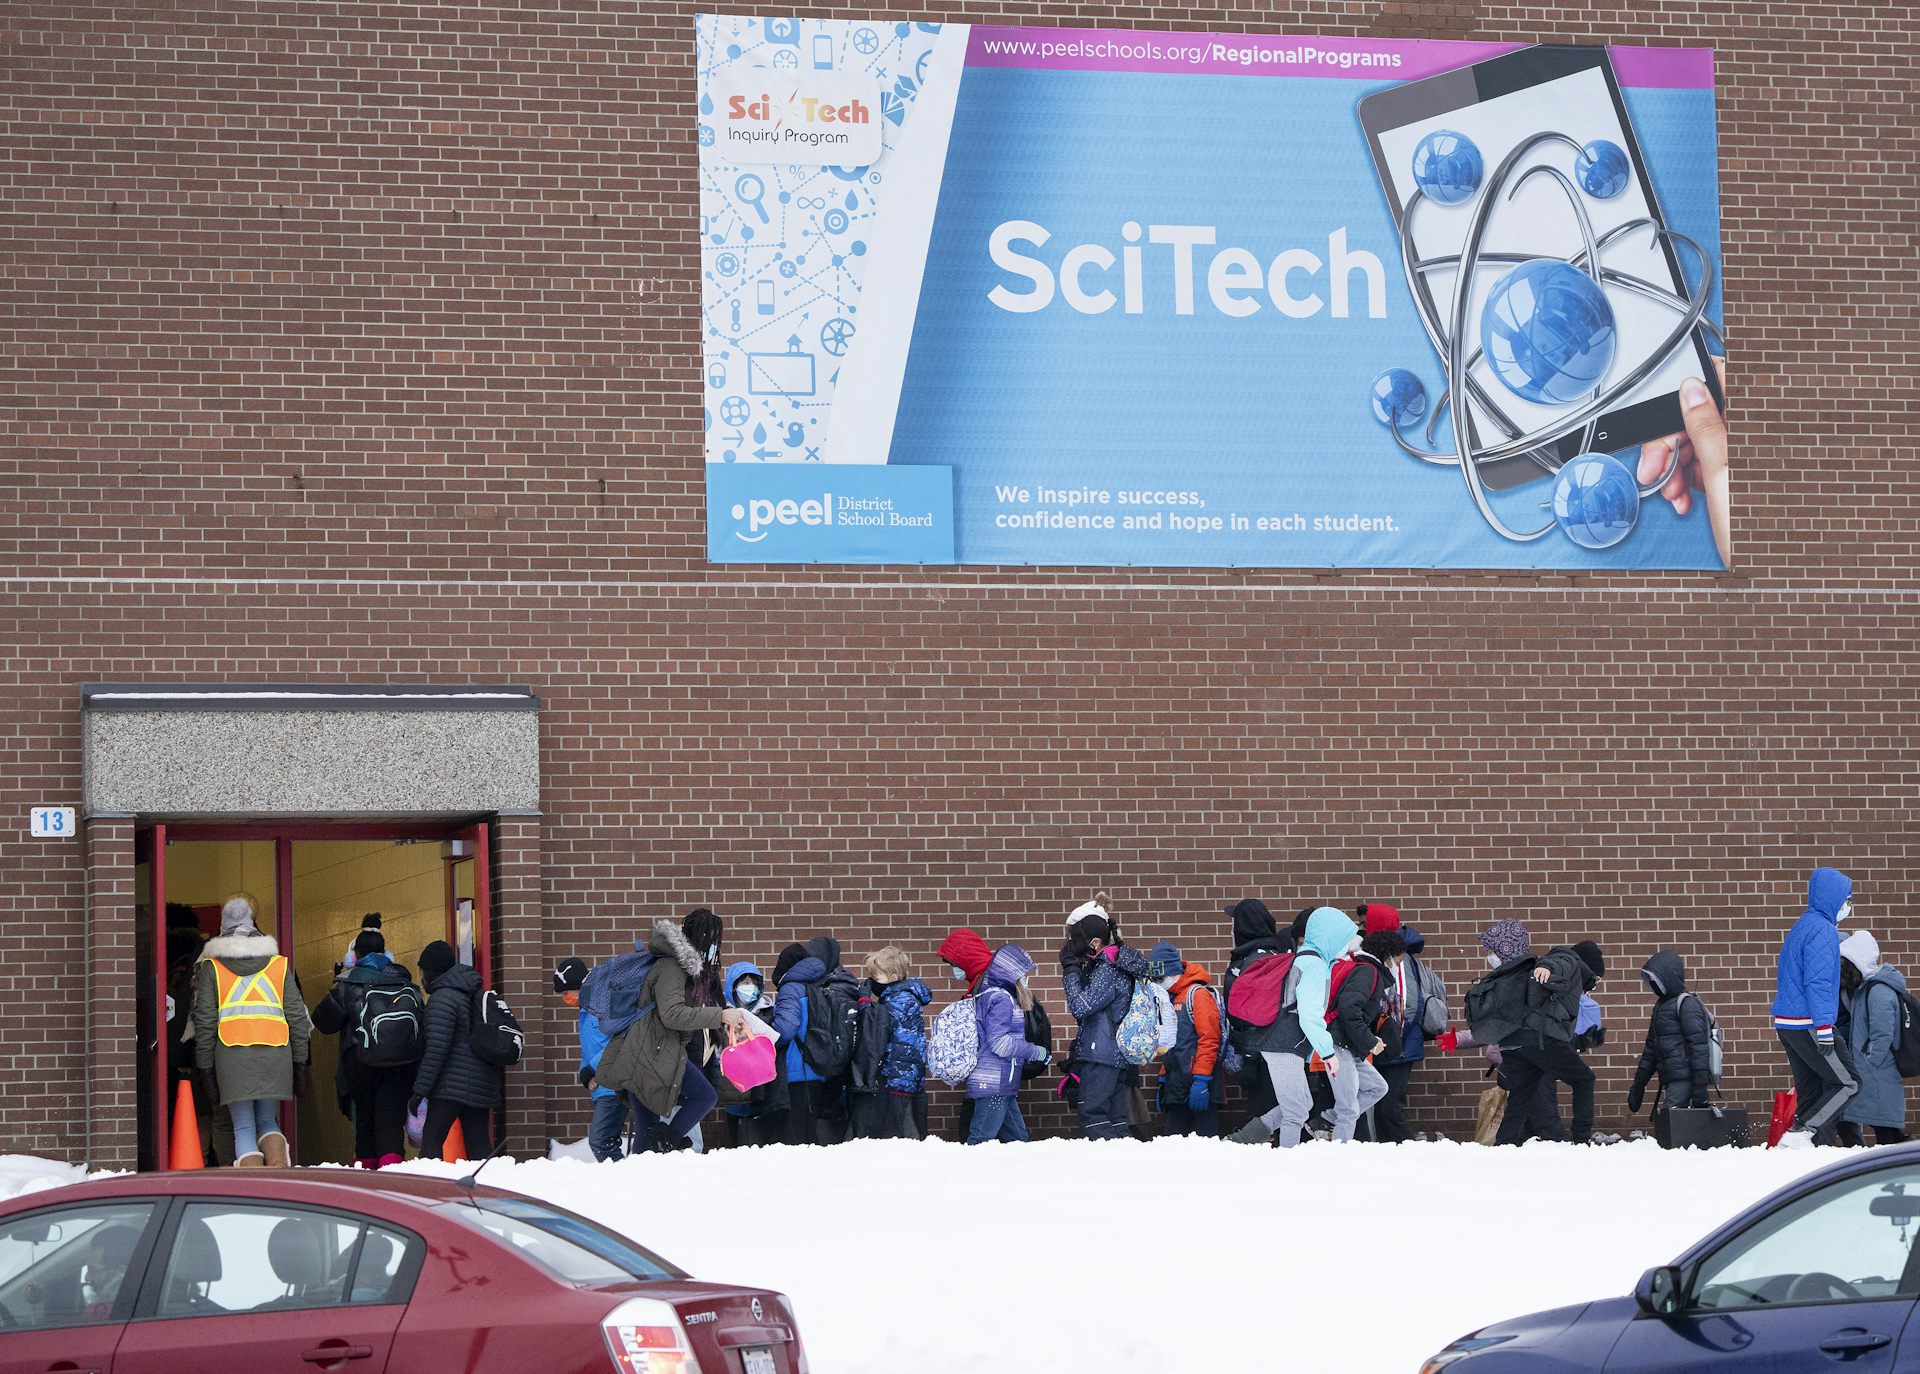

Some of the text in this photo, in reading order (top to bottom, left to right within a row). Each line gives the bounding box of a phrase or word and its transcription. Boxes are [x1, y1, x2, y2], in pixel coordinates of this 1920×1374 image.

[983, 38, 1402, 68] www.peelschools.org/RegionalPrograms
[728, 93, 869, 124] Sci Tech
[728, 126, 849, 147] Inquiry Program
[986, 219, 1387, 320] SciTech
[837, 496, 894, 511] District
[995, 485, 1206, 509] We inspire success,
[750, 493, 833, 532] peel
[837, 511, 933, 528] School Board
[995, 511, 1400, 535] confidence and hope in each student.
[40, 811, 64, 831] 13
[684, 1311, 718, 1325] SENTRA
